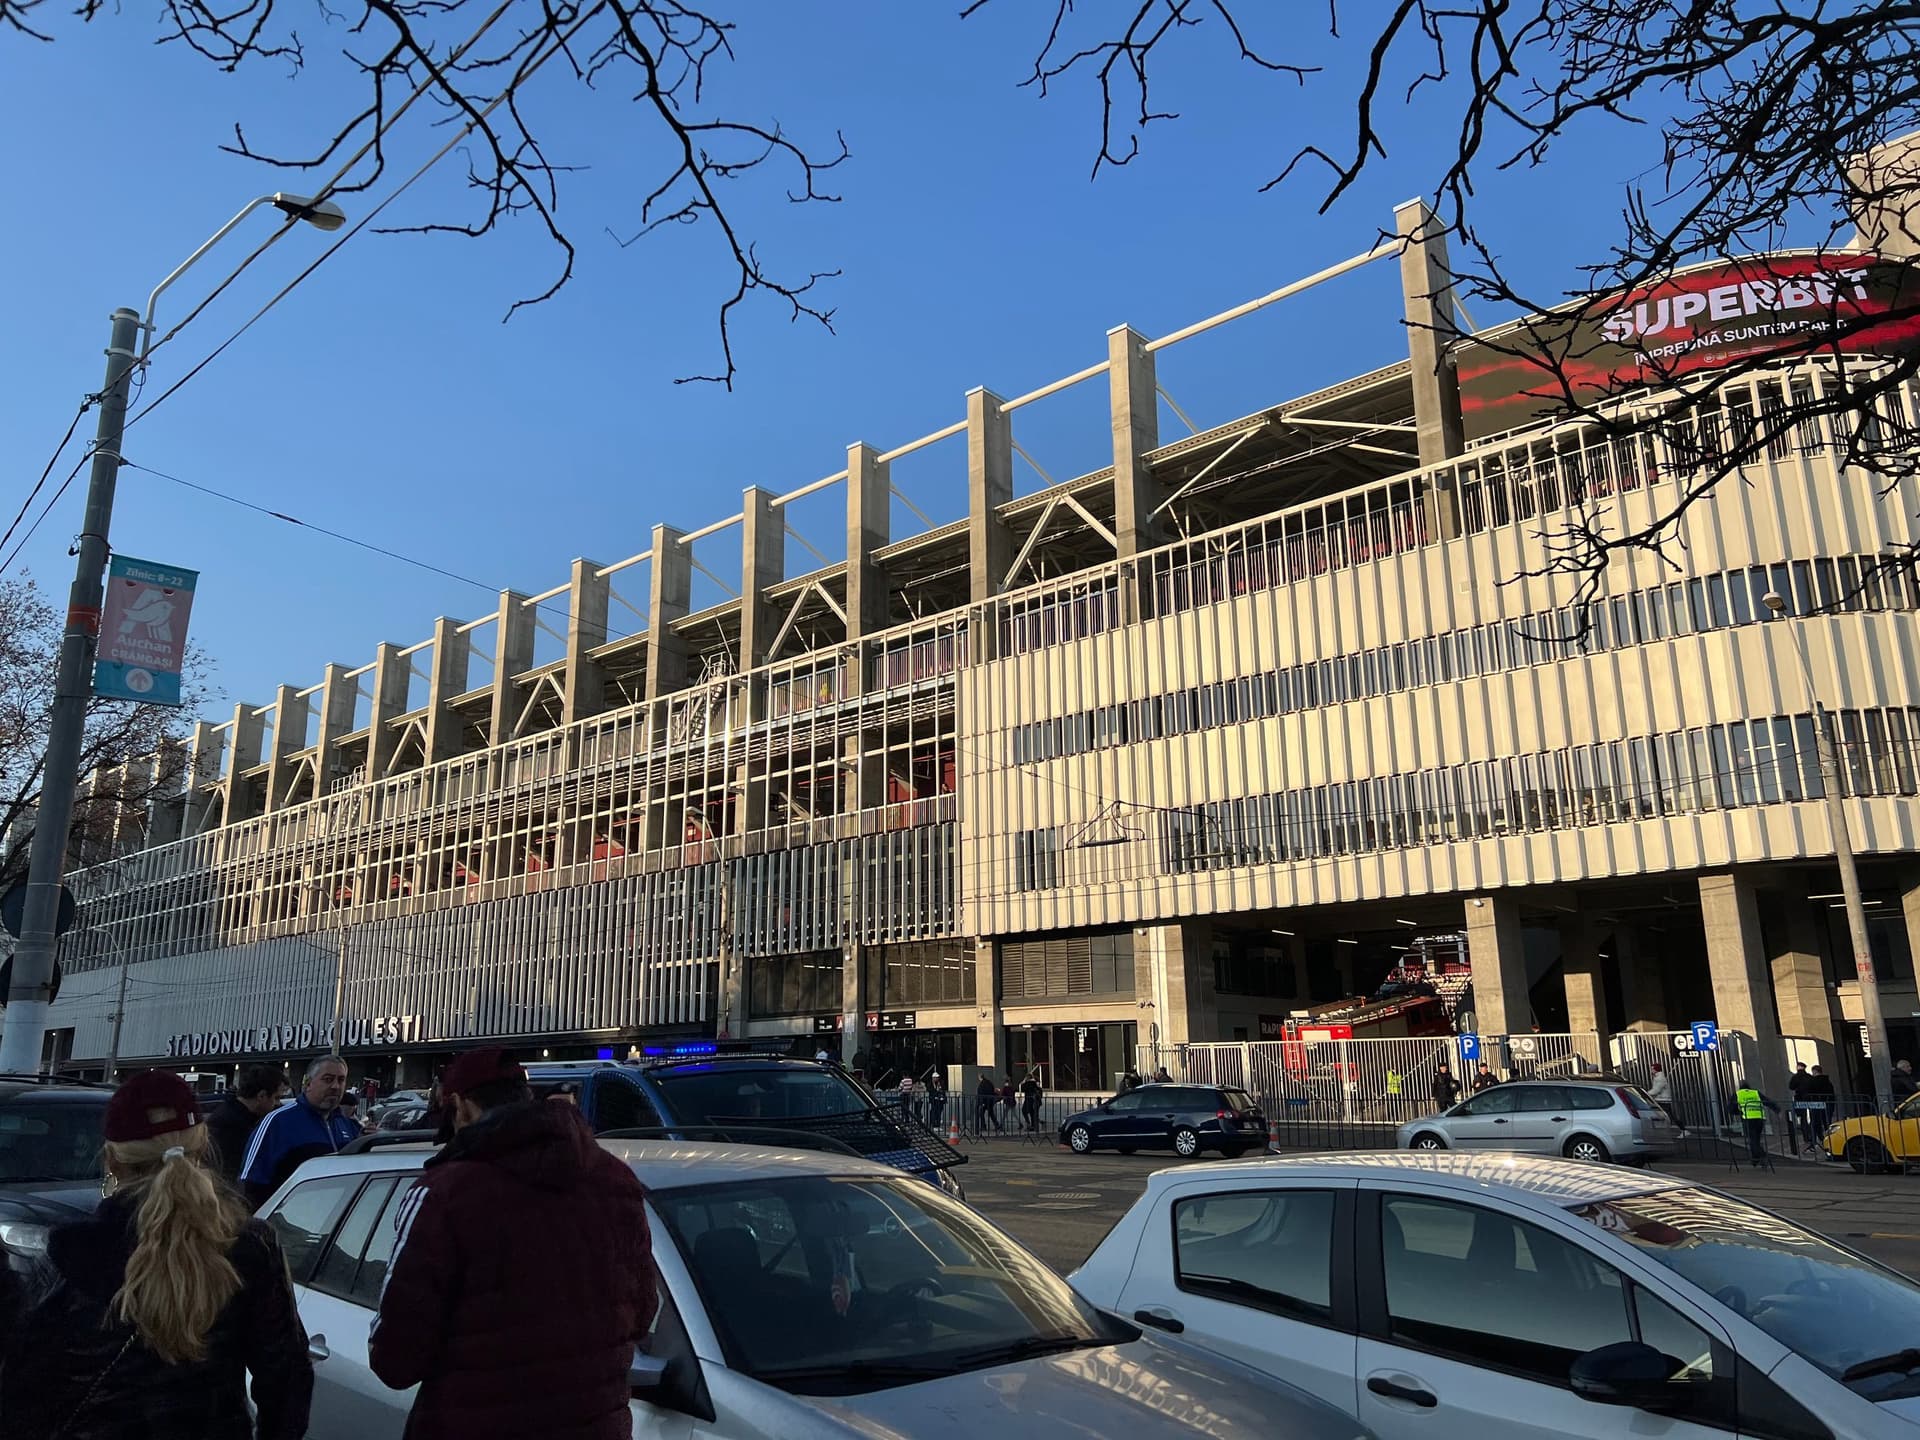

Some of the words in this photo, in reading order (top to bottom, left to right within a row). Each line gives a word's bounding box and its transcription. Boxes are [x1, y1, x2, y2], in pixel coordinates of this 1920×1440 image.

[1600, 268, 1868, 342] SUPERBET
[117, 634, 172, 654] Auchan
[866, 1017, 878, 1027] A2
[166, 1028, 252, 1057] STADIONUL
[258, 1023, 313, 1052] RAPID
[1463, 1039, 1474, 1054] P
[1697, 1028, 1710, 1045] P
[1859, 1025, 1872, 1058] MUZEU
